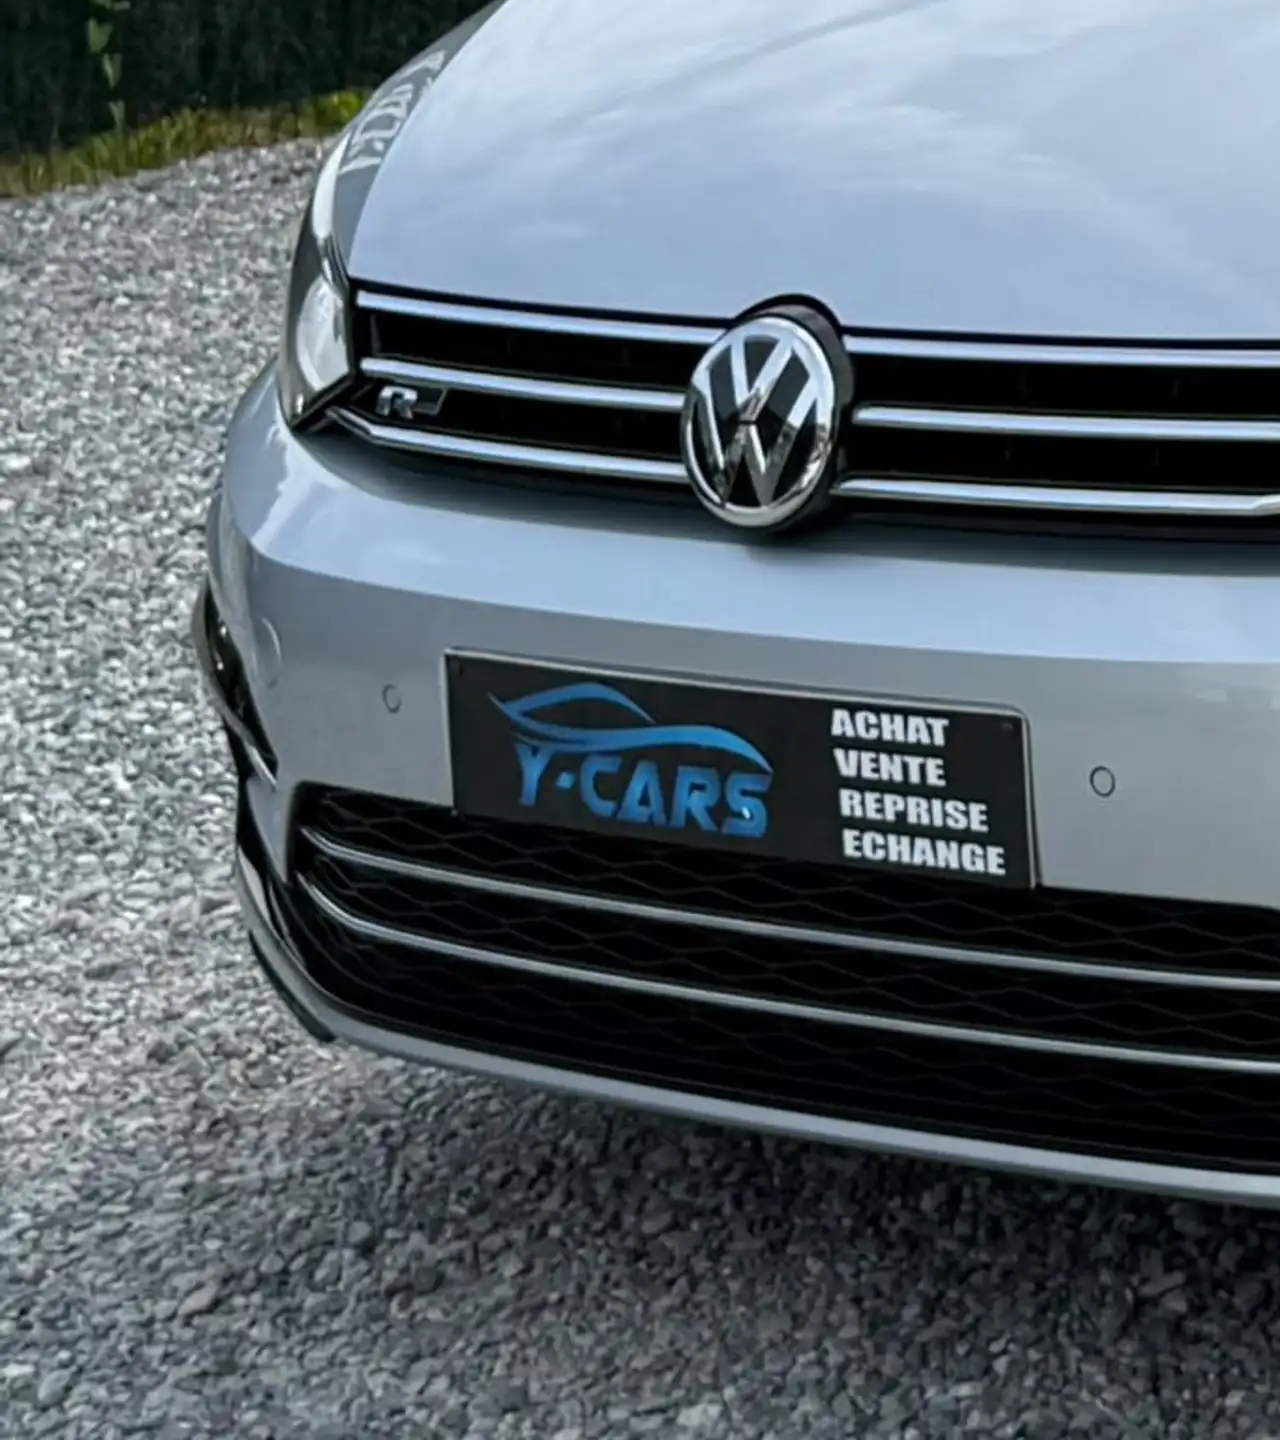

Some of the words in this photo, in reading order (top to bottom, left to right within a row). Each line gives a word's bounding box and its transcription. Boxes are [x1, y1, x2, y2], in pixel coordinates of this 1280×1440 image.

[831, 708, 950, 747] ACHAT
[833, 747, 947, 787] VENTE
[514, 742, 772, 838] Y-CARS
[839, 788, 990, 833] REPRISE
[842, 828, 1007, 876] ECHANGE
